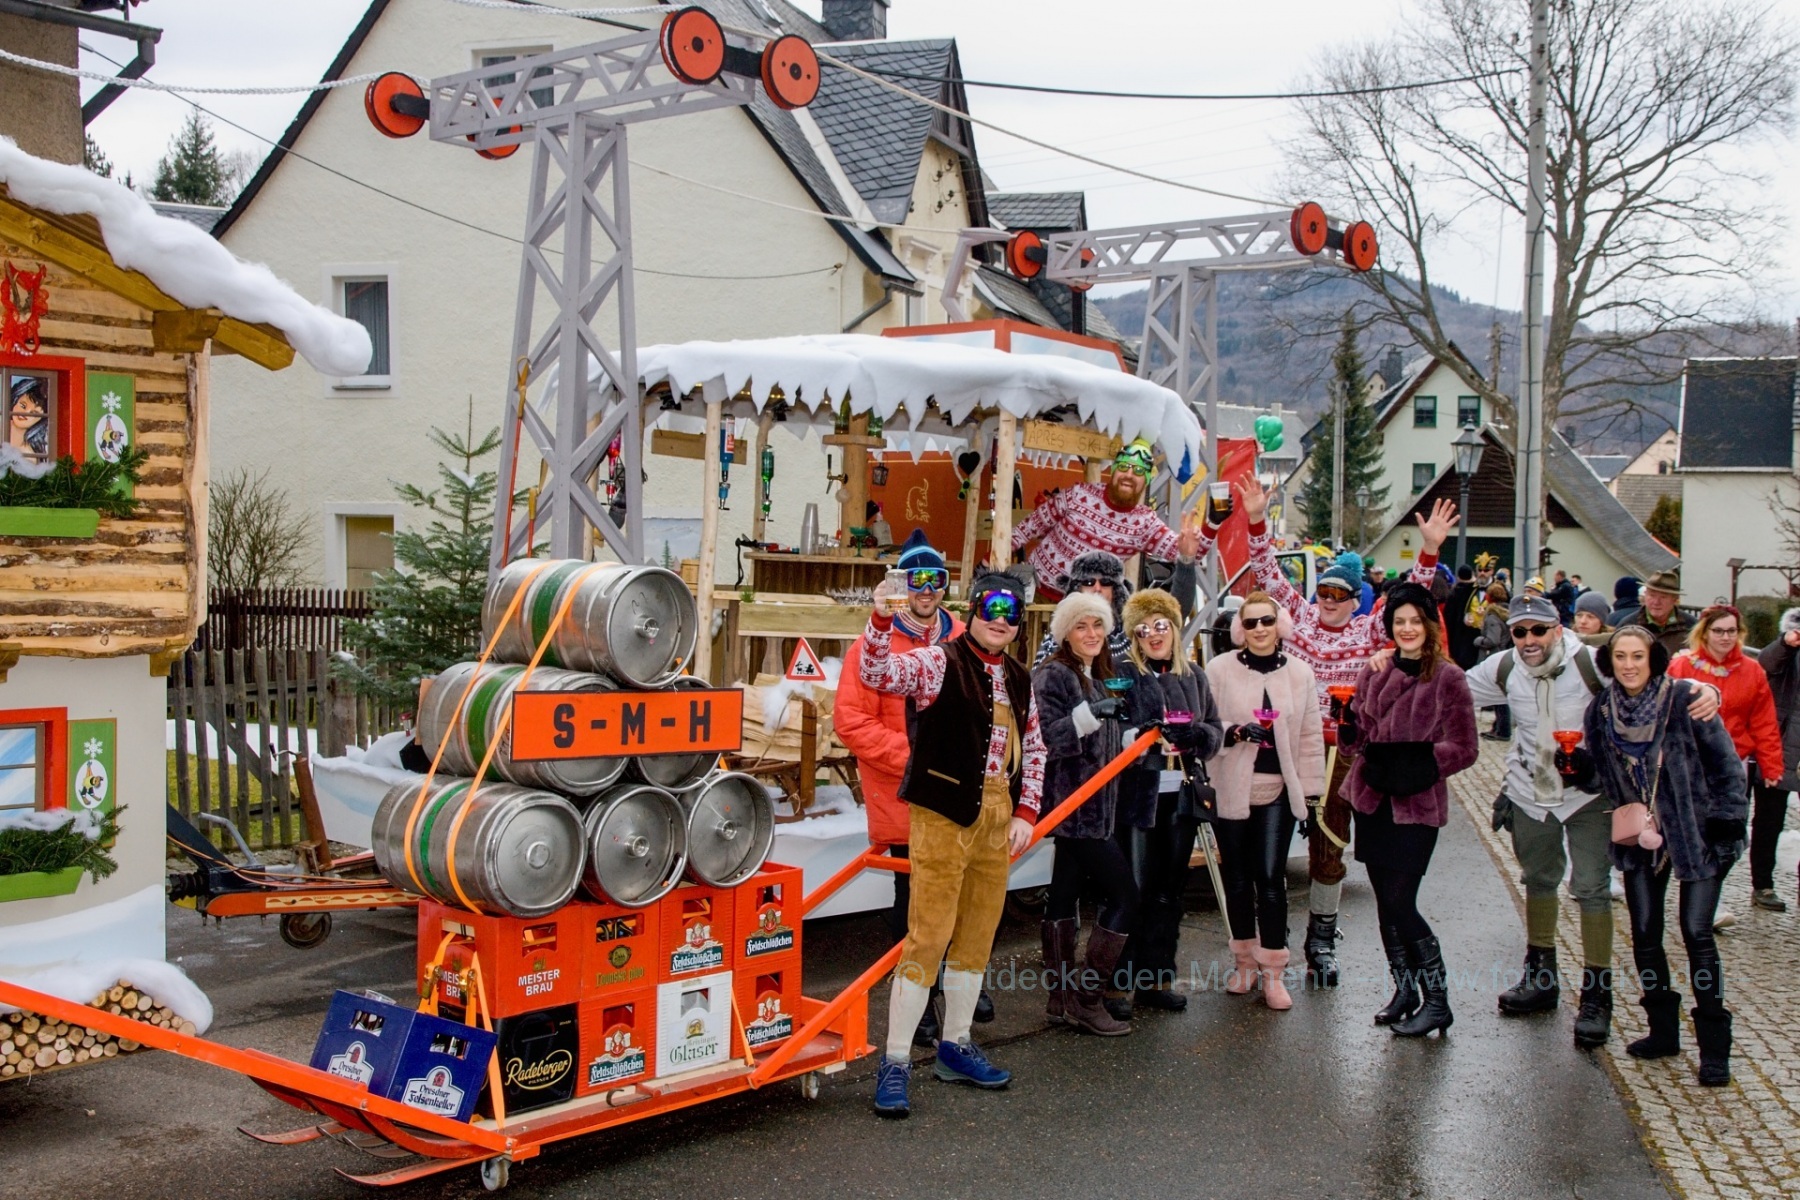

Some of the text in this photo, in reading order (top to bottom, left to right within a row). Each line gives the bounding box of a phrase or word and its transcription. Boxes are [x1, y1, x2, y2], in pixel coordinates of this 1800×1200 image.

[747, 936, 793, 956] Feldschlößchen
[518, 968, 561, 987] MEISTER
[338, 1061, 363, 1076] Dresdner
[504, 1054, 570, 1088] Radeberger
[591, 1057, 644, 1082] Feldschlößchen
[408, 1090, 456, 1111] Felsenkeller
[420, 1084, 451, 1098] Dresdner
